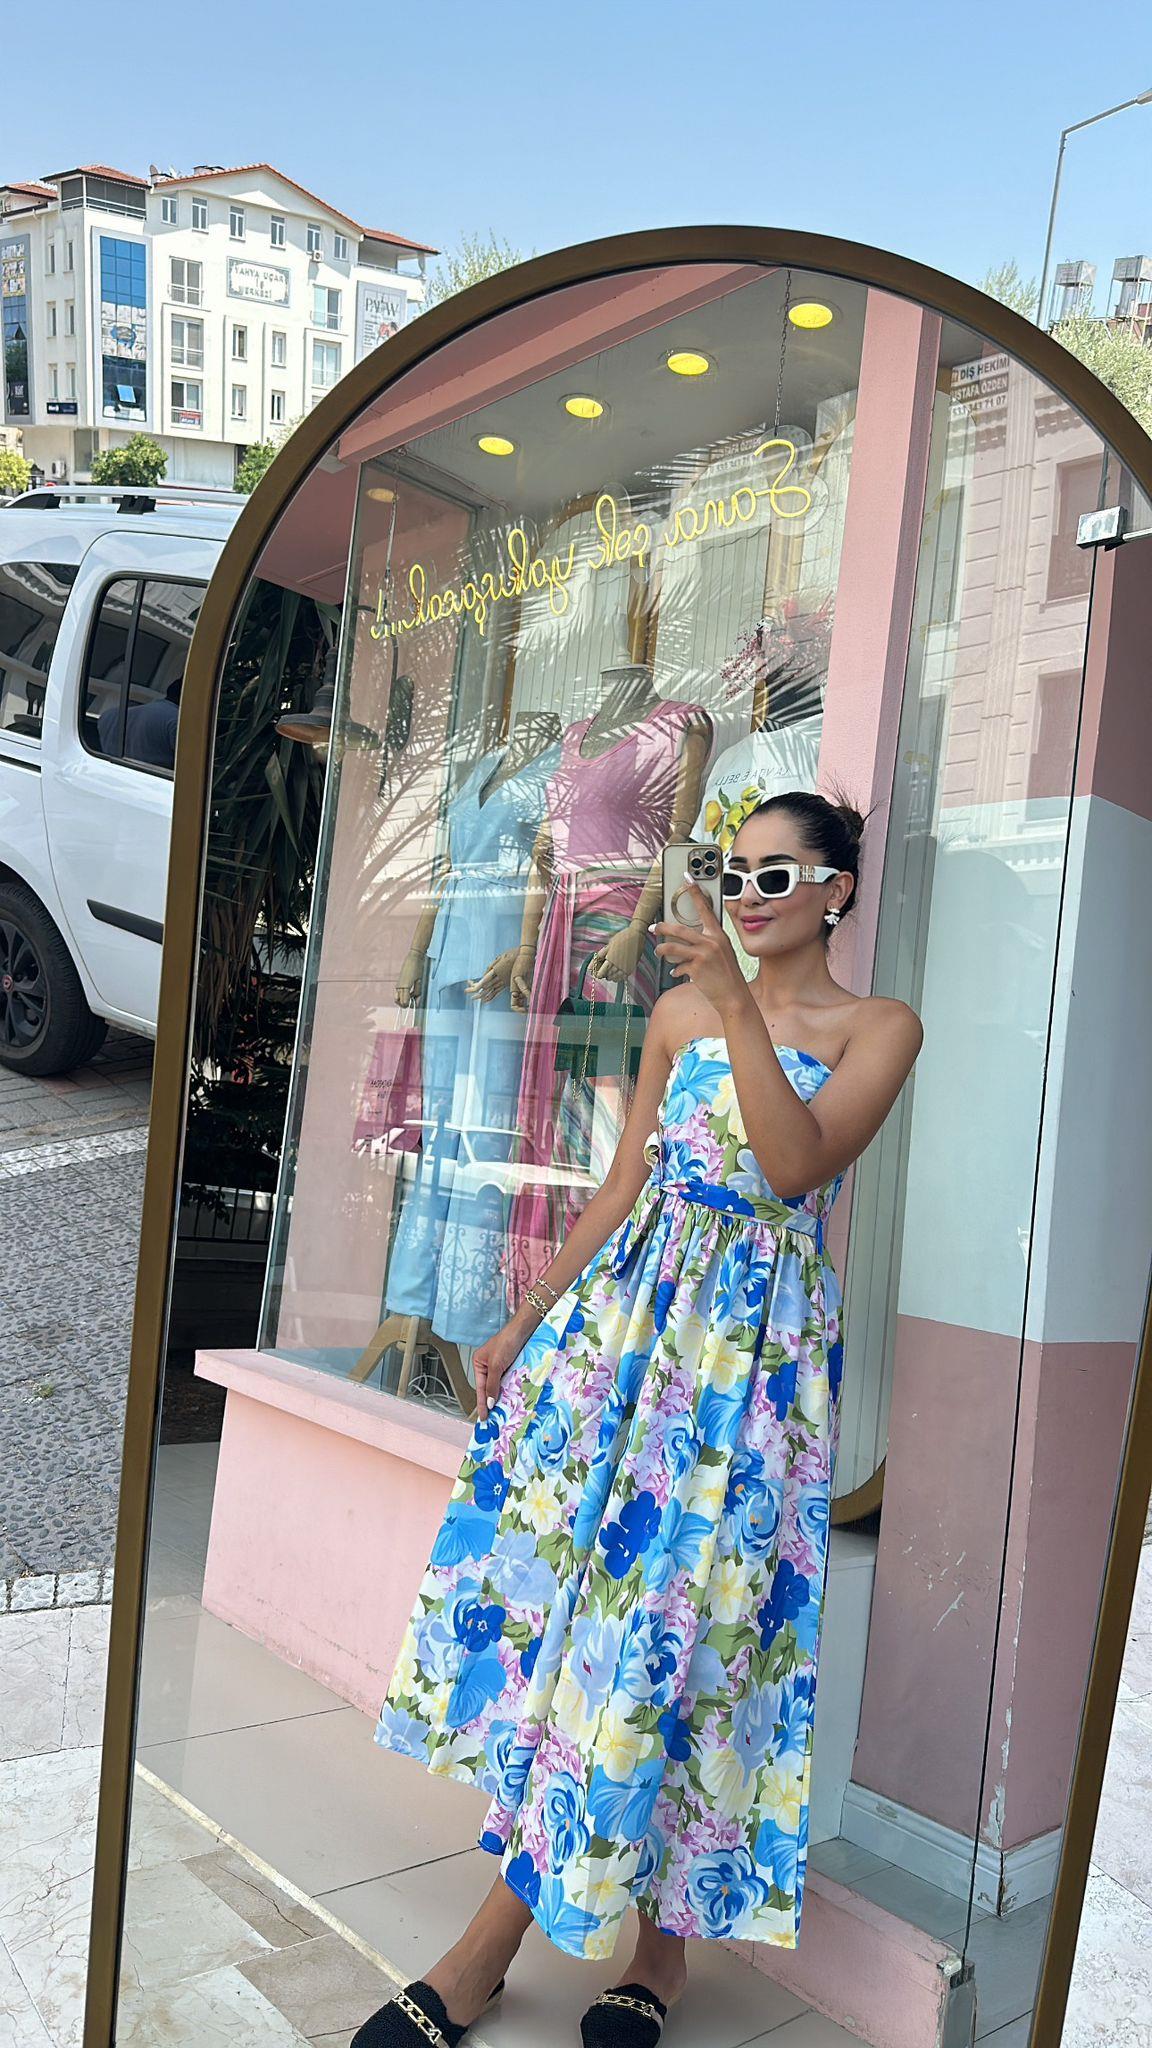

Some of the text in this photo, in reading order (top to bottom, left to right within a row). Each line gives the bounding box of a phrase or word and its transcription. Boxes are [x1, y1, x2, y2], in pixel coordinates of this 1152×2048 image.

[234, 265, 260, 278] YAHYA
[960, 358, 1009, 380] DİŞ HEKİMİ
[980, 376, 1008, 394] ÖZDEN
